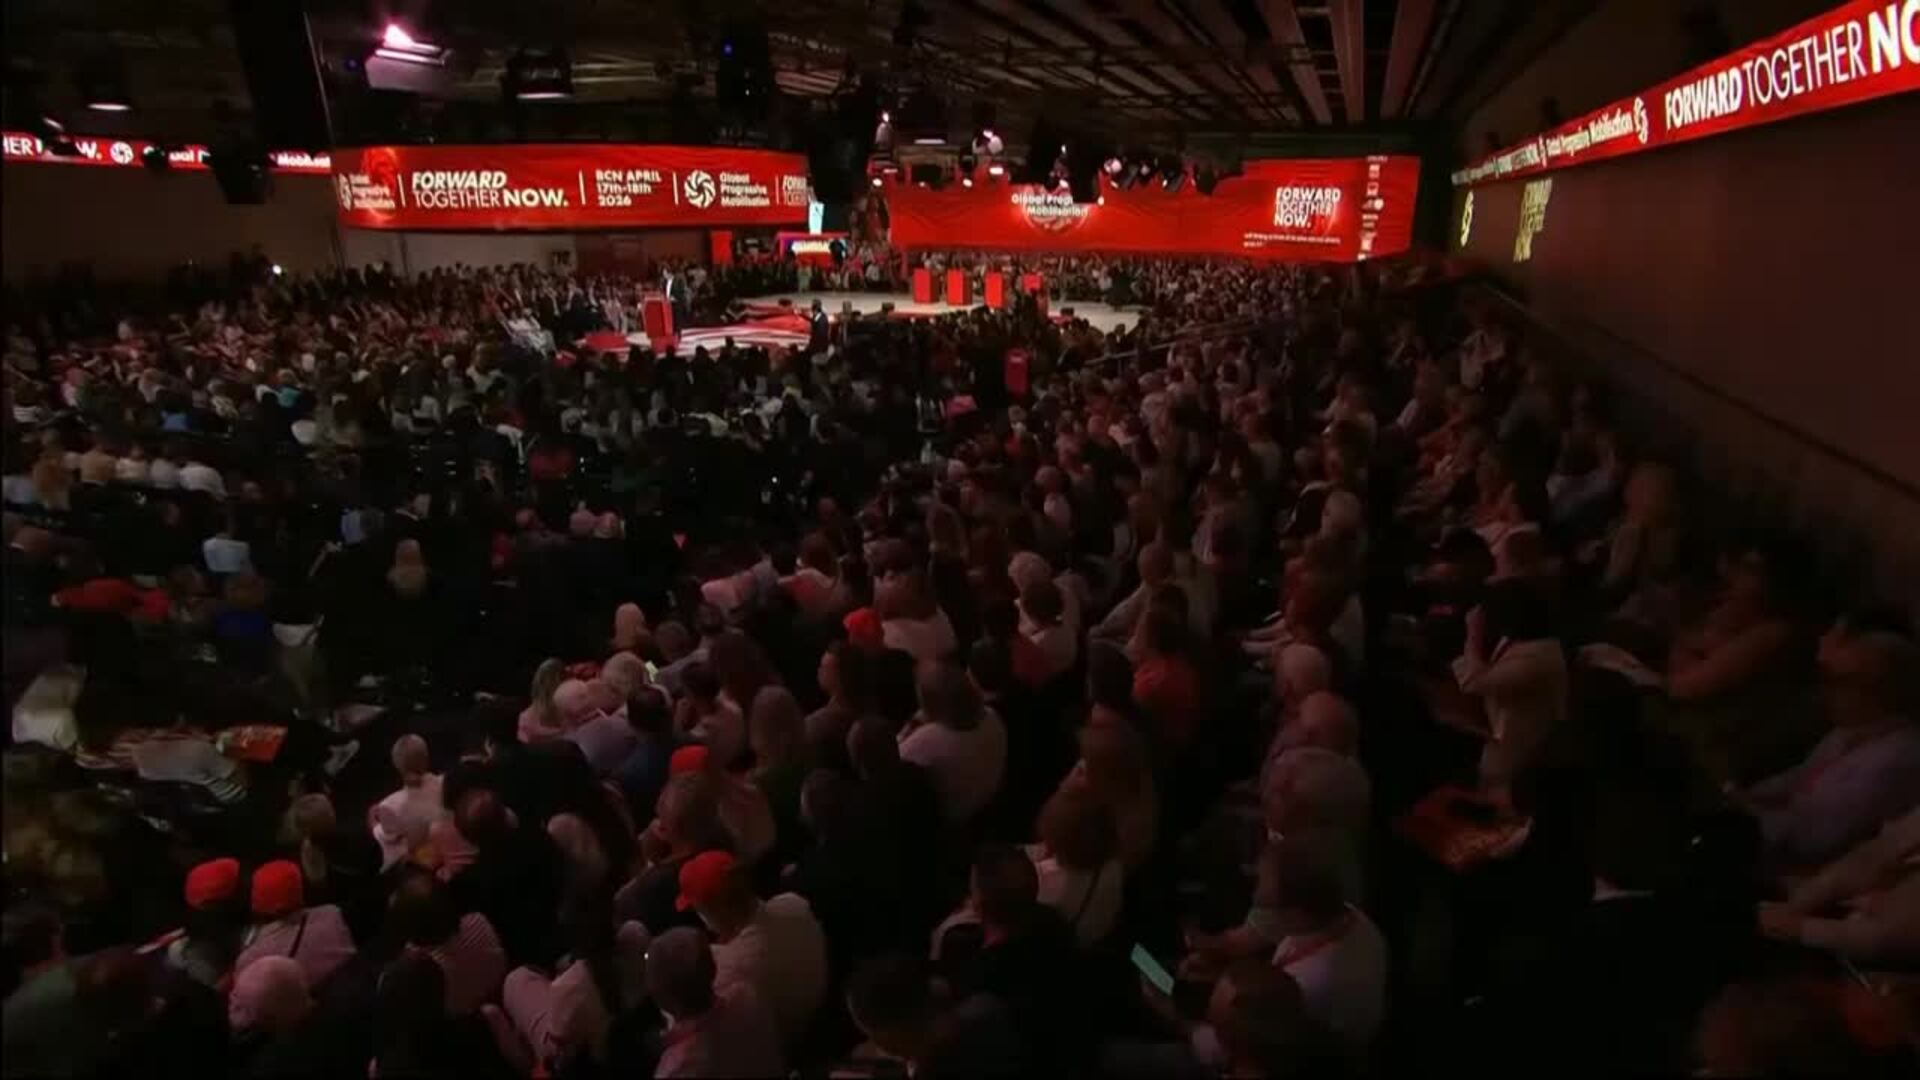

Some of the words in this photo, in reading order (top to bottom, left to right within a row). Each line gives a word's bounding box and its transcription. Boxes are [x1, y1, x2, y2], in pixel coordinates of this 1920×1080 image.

[1665, 66, 1743, 132] FORWARD
[1743, 20, 1868, 107] TOGETHER
[411, 170, 508, 190] FORWARD
[595, 169, 623, 182] BCN
[626, 169, 662, 182] APRIL
[720, 172, 750, 184] Global
[411, 188, 501, 209] TOGETHER
[502, 188, 569, 208] NOW.
[597, 194, 632, 207] 2026
[1011, 191, 1045, 204] Global
[1277, 186, 1341, 203] FORWARD
[1026, 205, 1089, 217] Mobilisation
[1275, 200, 1334, 217] TOGETHER
[1274, 213, 1312, 229] NOW.
